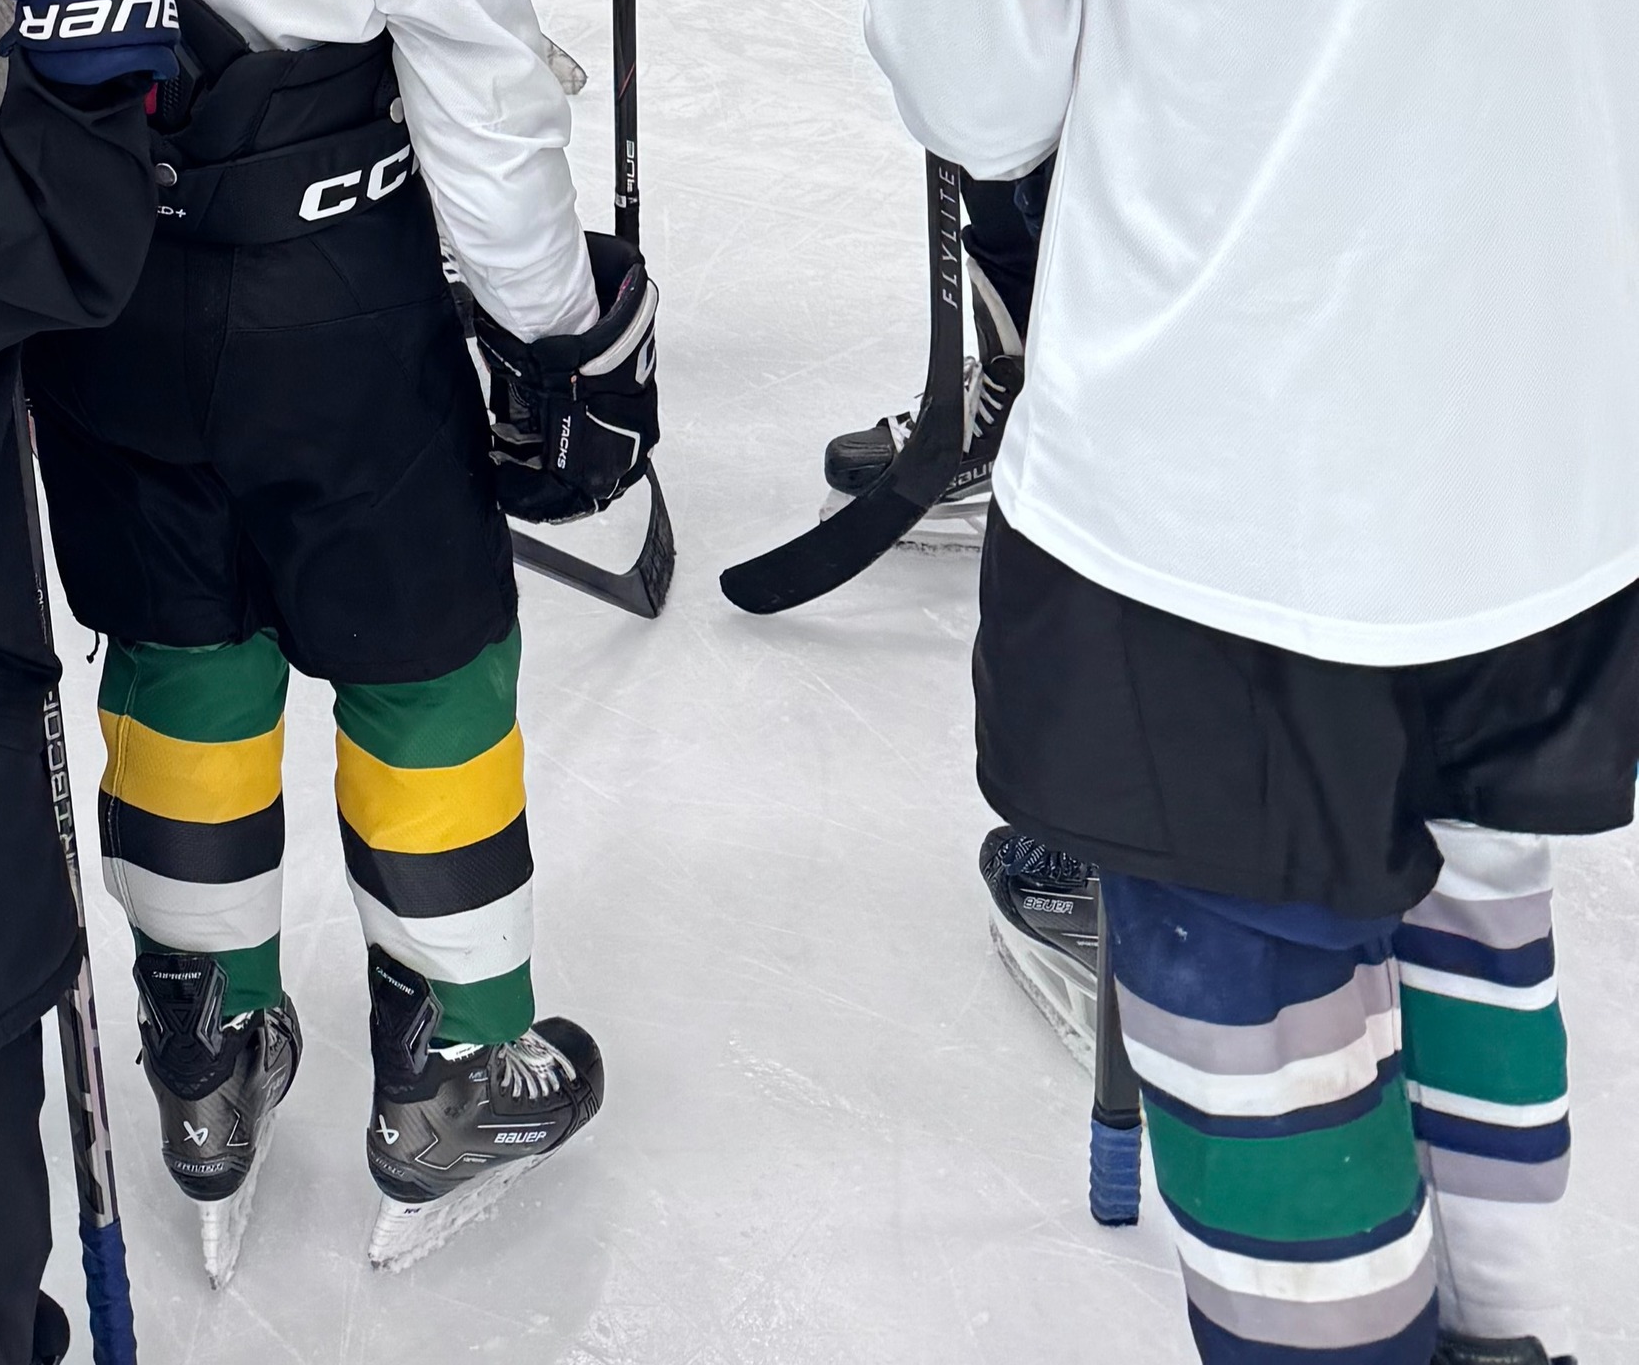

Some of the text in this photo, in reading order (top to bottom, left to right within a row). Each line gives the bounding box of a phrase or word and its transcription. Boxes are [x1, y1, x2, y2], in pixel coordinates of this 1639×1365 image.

[298, 143, 420, 222] CC
[939, 166, 959, 310] FLYLITE
[557, 415, 572, 470] TACKS
[1023, 896, 1074, 915] BAUER
[494, 1131, 547, 1144] BAUER
